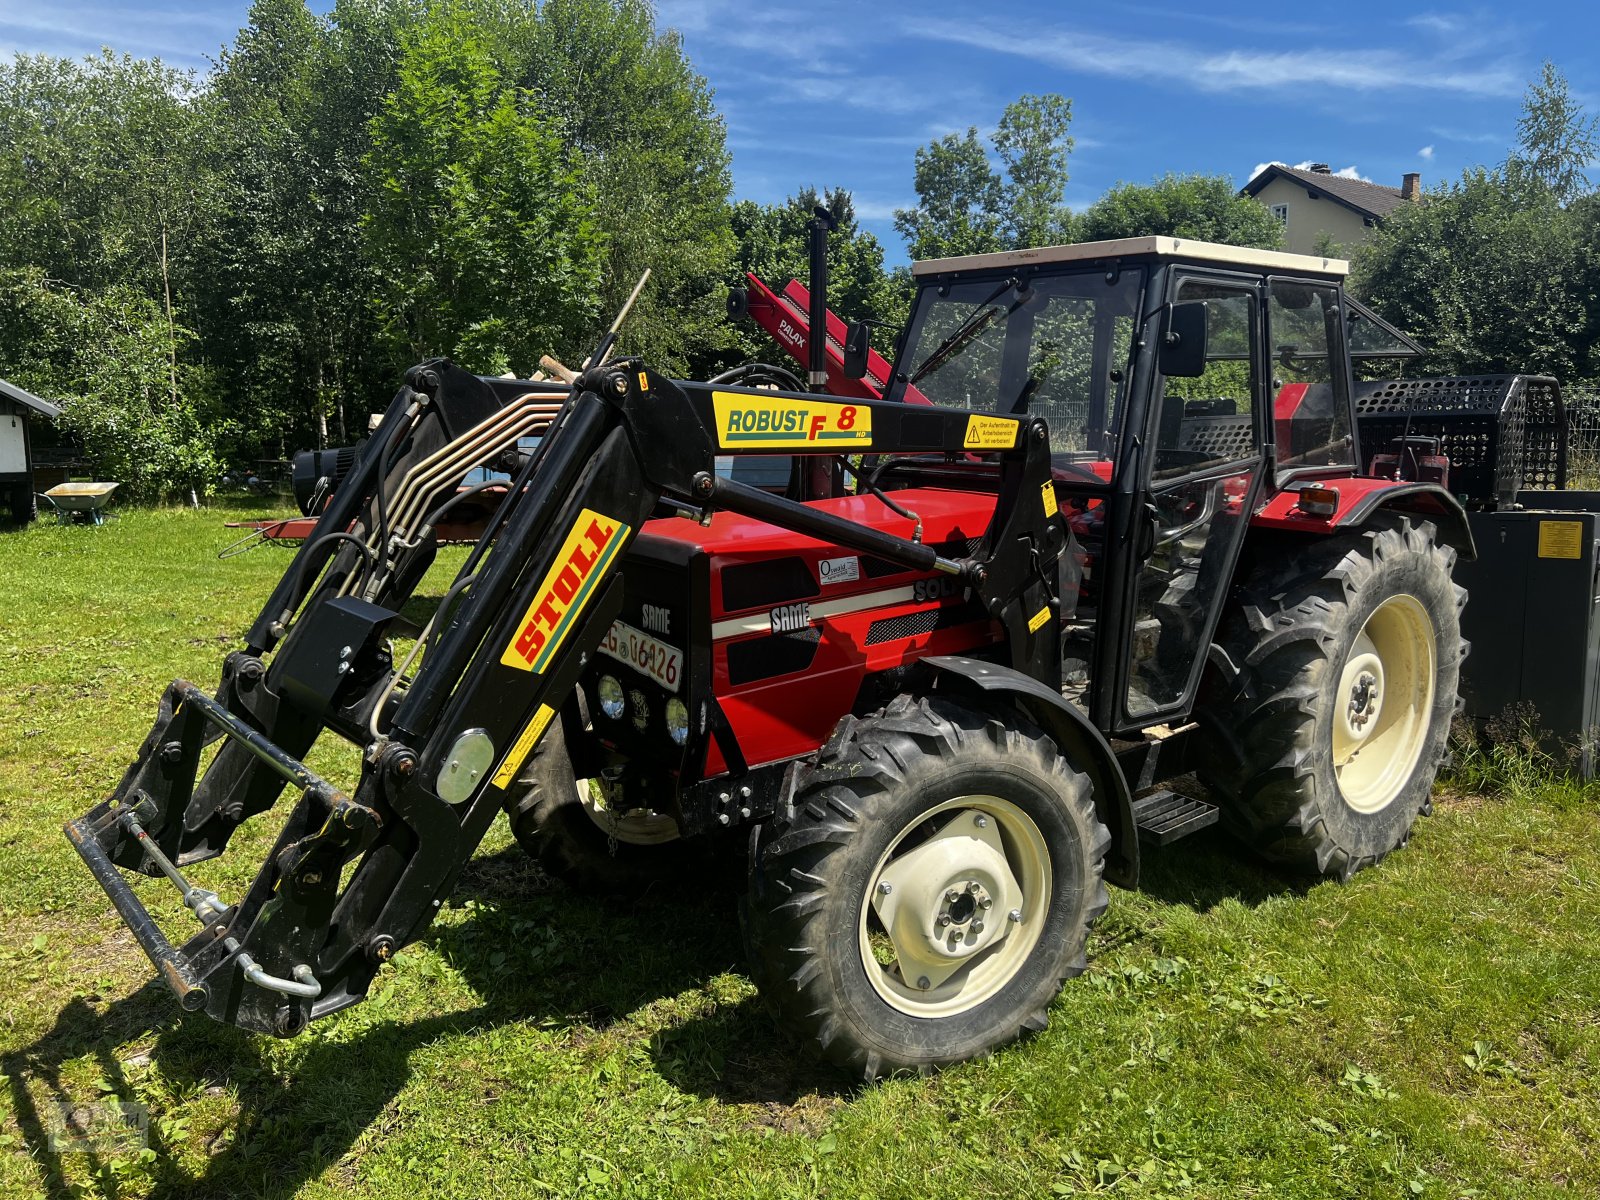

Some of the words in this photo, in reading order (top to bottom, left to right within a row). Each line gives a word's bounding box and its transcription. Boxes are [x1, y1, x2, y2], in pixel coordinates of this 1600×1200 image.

[780, 319, 806, 349] PALAX
[727, 409, 809, 432] ROBUST
[808, 415, 827, 441] F
[836, 405, 857, 431] 8
[820, 560, 847, 576] Oswald
[514, 518, 614, 665] STOLL
[642, 603, 671, 635] SAME
[770, 602, 811, 633] SAME
[629, 634, 677, 685] 06126
